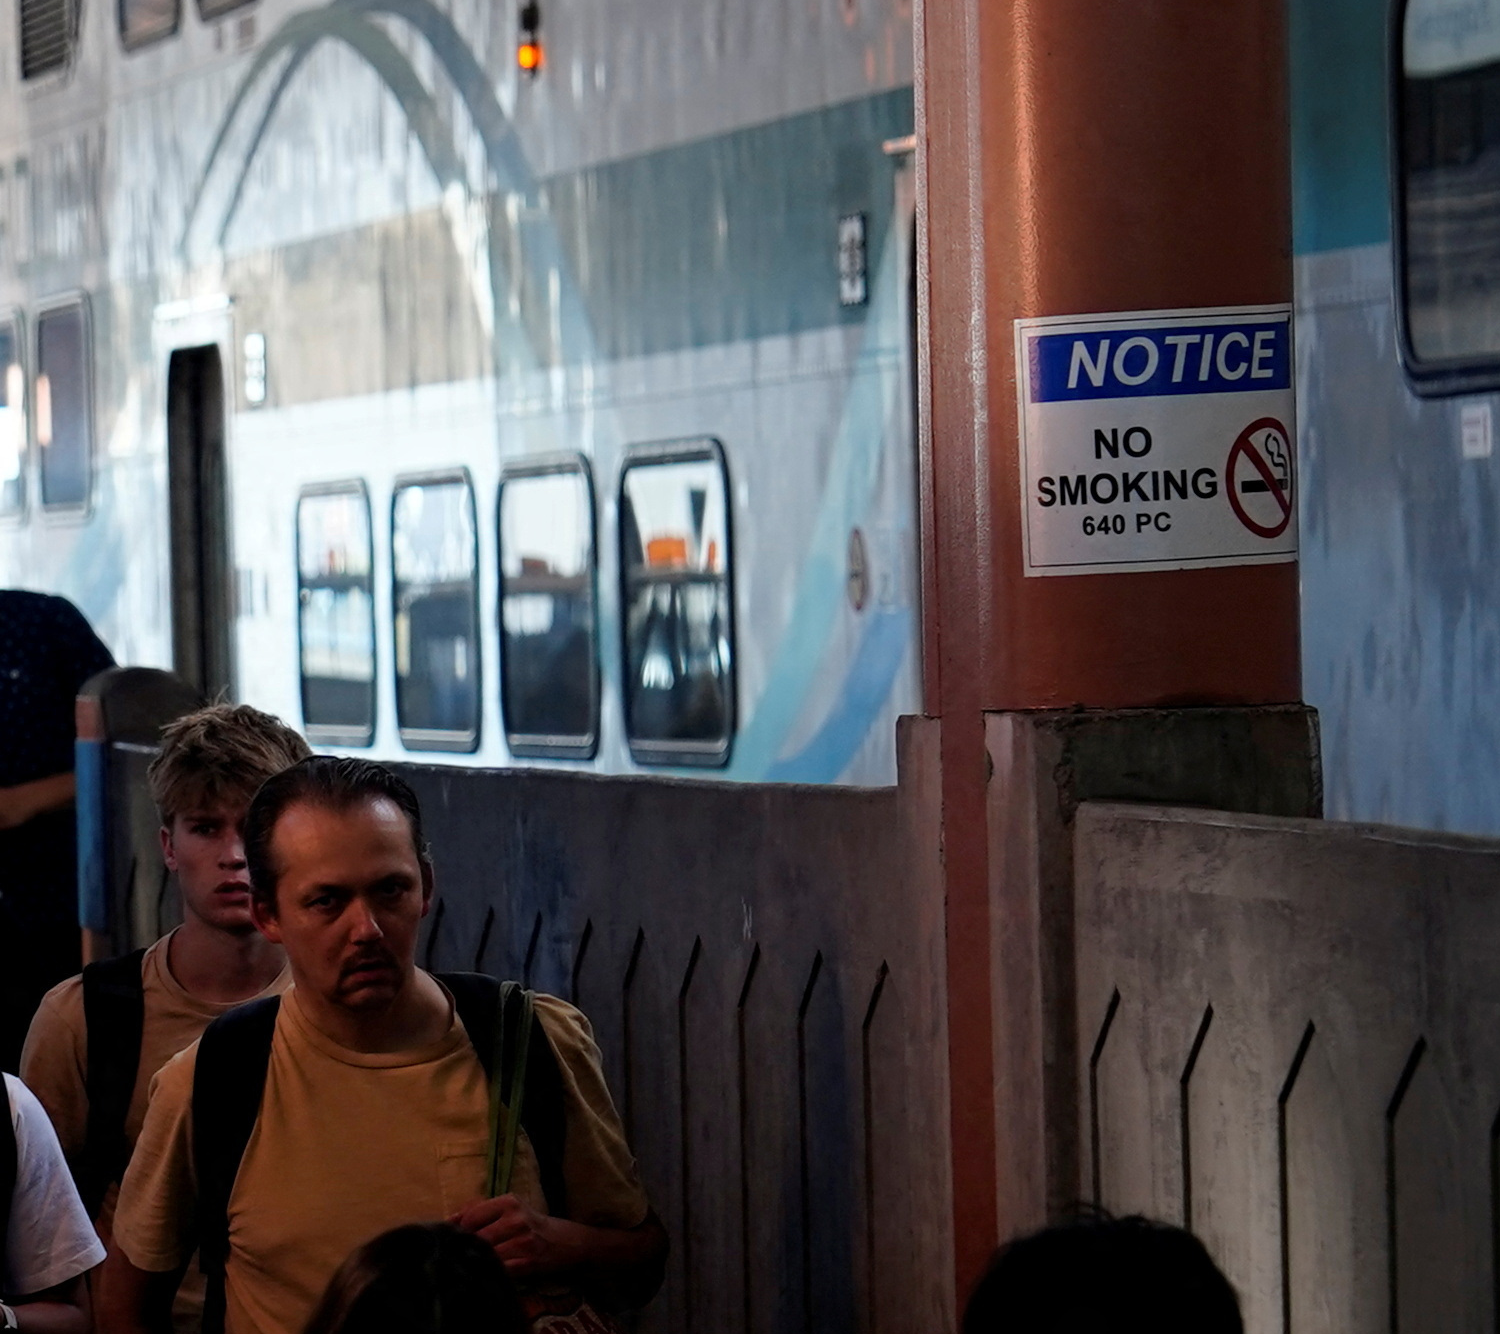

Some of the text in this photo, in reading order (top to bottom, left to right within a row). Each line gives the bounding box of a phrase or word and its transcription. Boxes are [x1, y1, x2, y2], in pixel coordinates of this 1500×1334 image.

[1066, 329, 1276, 389] NOTICE
[1093, 425, 1152, 459] NO
[1036, 467, 1218, 507] SMOKING
[1081, 511, 1172, 536] 640 PC
